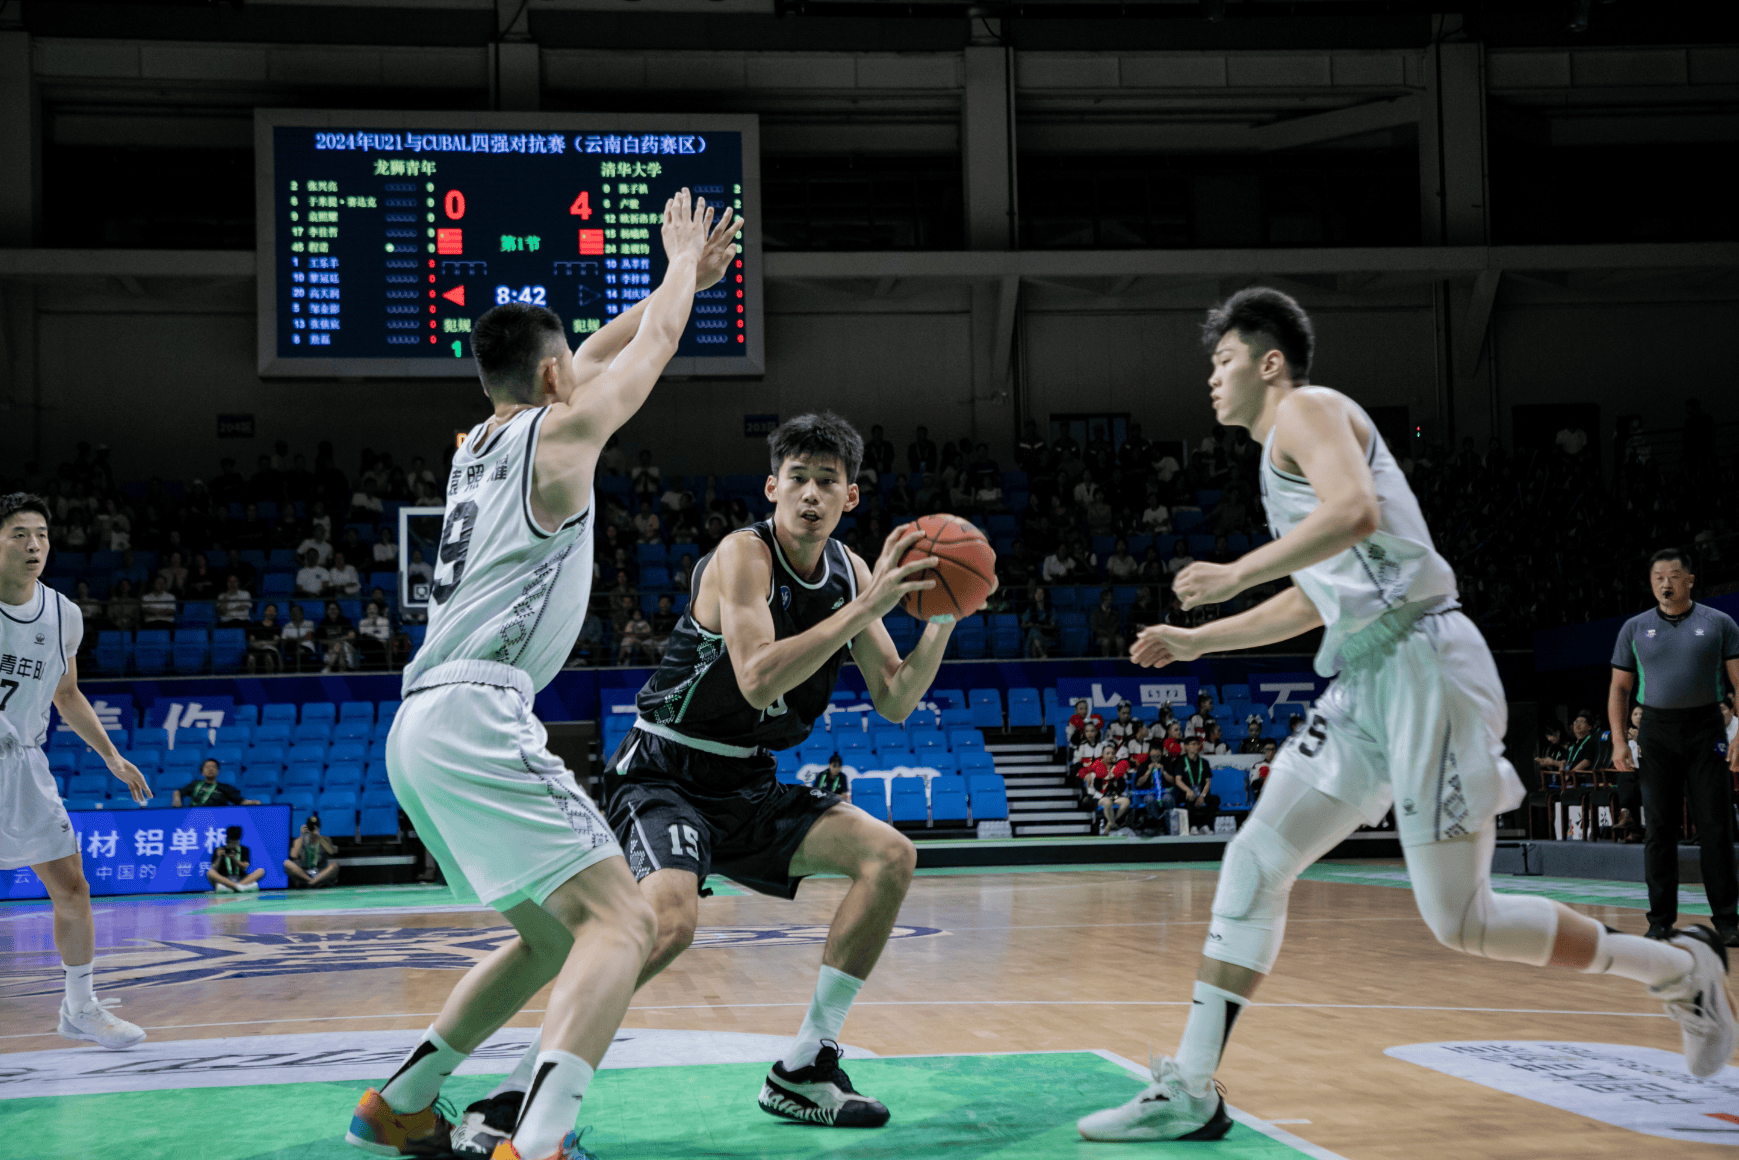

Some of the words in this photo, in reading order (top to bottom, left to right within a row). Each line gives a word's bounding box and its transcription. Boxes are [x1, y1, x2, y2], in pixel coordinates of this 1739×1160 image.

[375, 159, 436, 176] 龙狮青年
[601, 162, 661, 177] 清华大学
[734, 184, 741, 193] 2
[445, 190, 465, 219] 0
[570, 191, 592, 220] 4
[734, 199, 741, 209] 2
[501, 235, 540, 252] 第1节
[605, 274, 616, 284] 11
[292, 287, 305, 298] 20
[495, 285, 547, 307] 8:42
[452, 341, 461, 357] 1
[432, 500, 479, 606] 9
[0, 678, 20, 711] 7
[668, 824, 699, 861] 15
